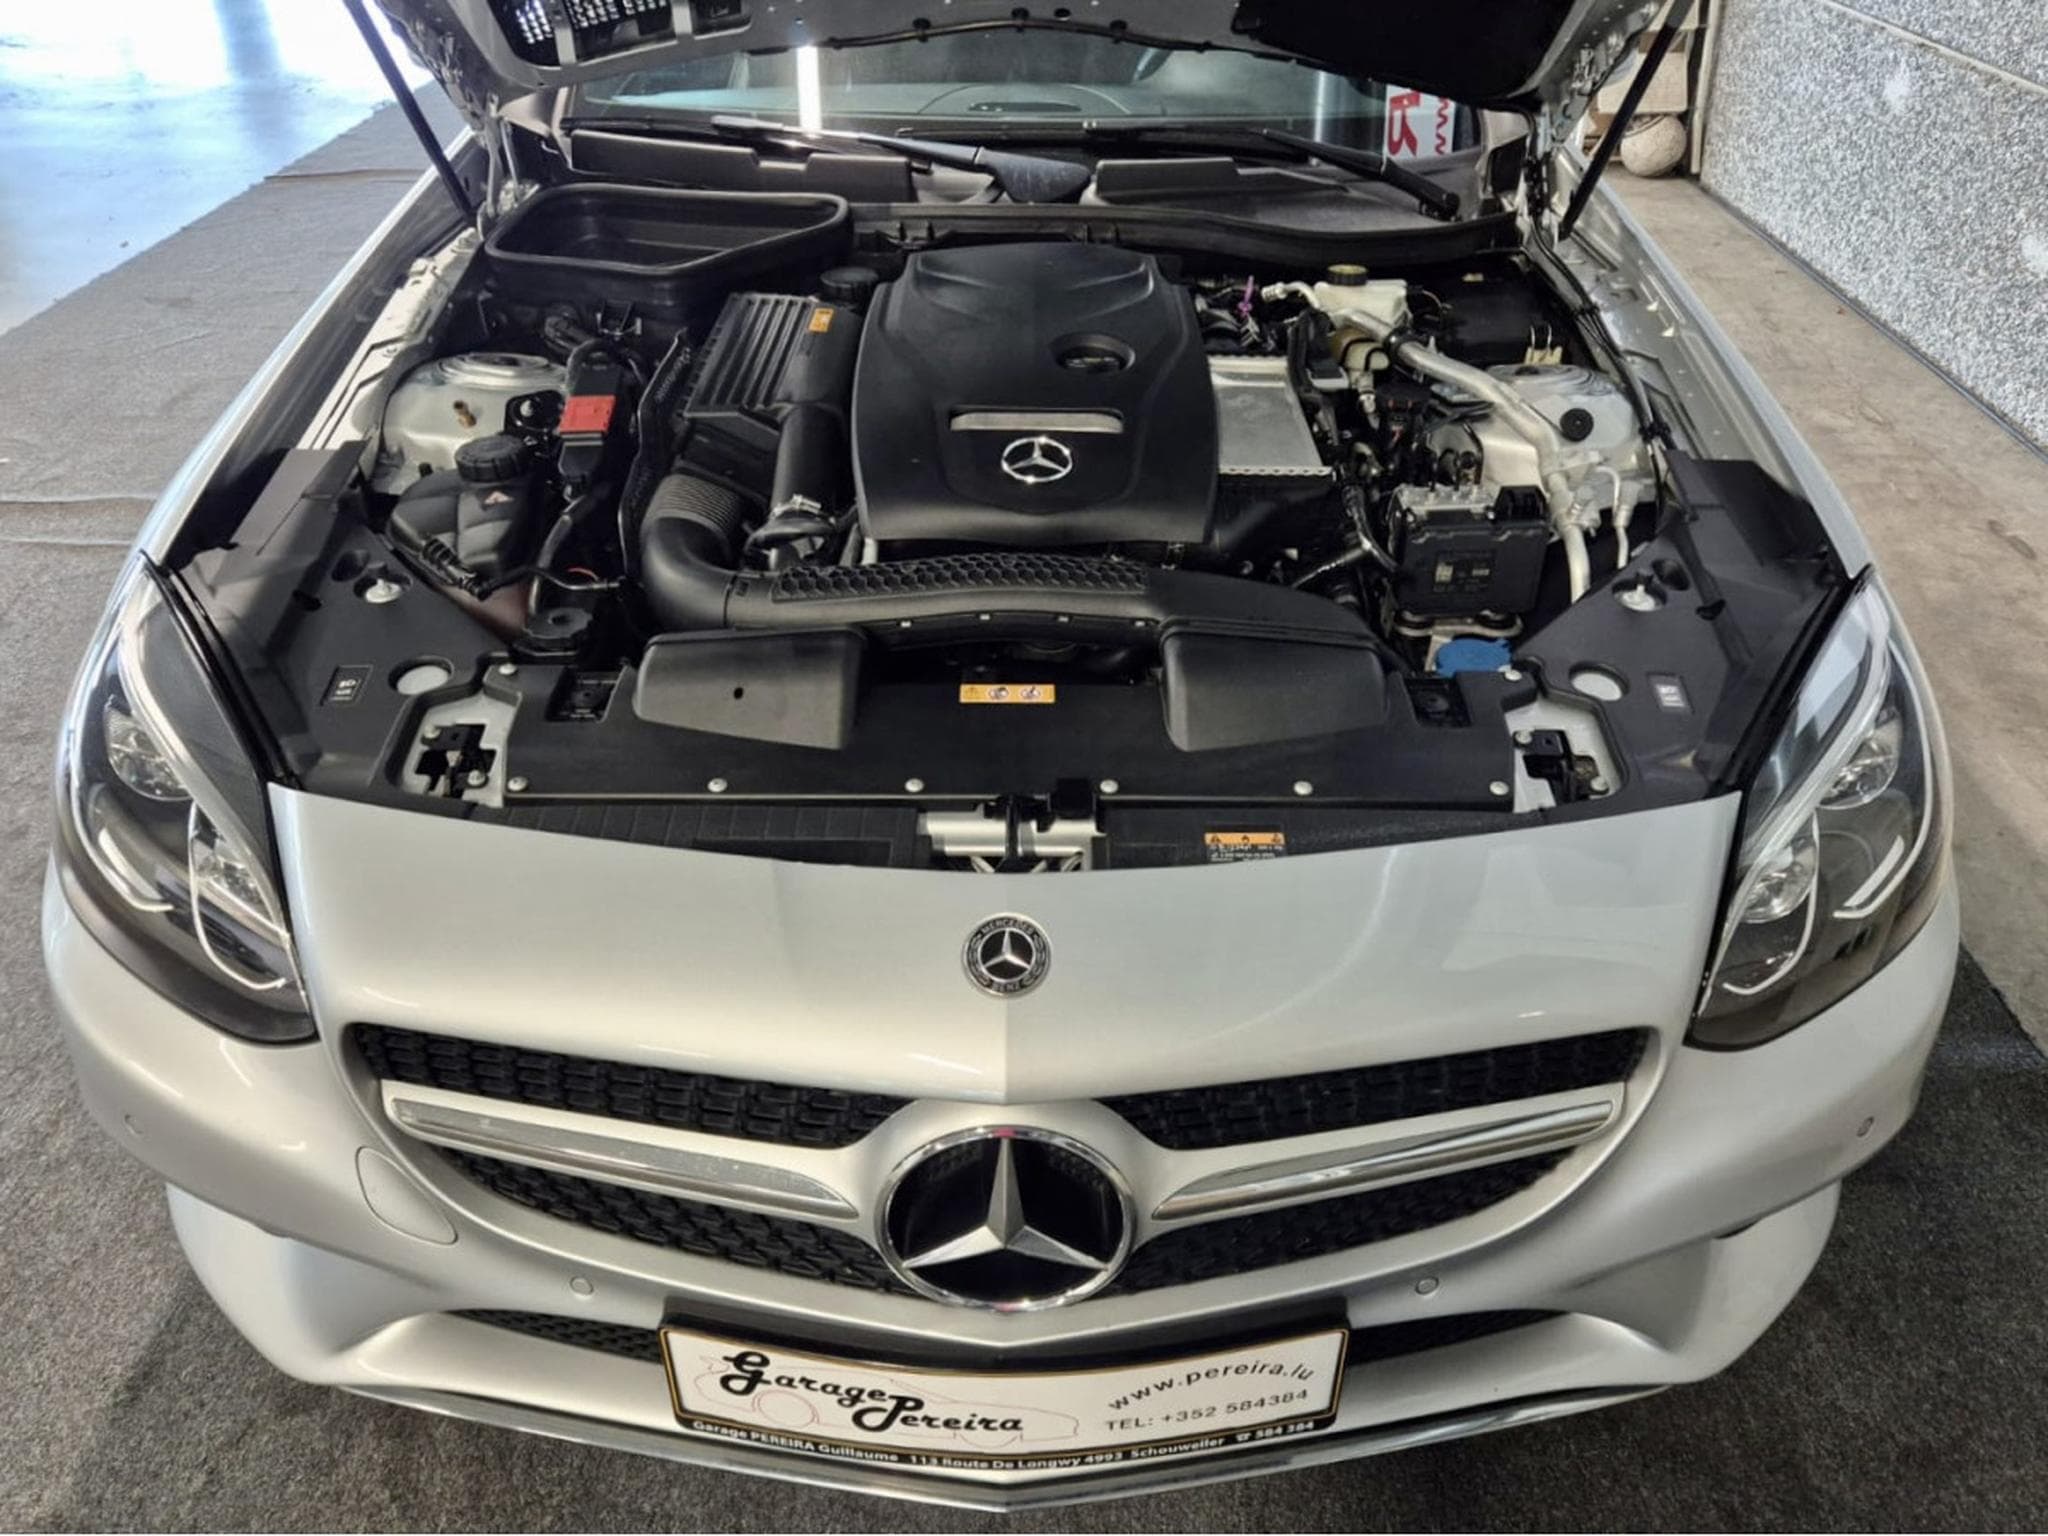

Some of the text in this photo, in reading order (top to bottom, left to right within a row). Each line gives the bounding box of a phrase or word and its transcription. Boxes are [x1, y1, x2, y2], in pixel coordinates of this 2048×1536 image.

[719, 1351, 886, 1407] Garage
[1109, 1360, 1314, 1410] www.pereira.lu
[852, 1394, 1023, 1432] Pereira
[1105, 1389, 1308, 1432] TEL: +352 584384
[693, 1420, 748, 1439] Garage
[750, 1431, 815, 1450] PEREIRA
[818, 1444, 899, 1461] Guillaume
[942, 1457, 989, 1470] Route
[992, 1459, 1014, 1469] De
[1018, 1453, 1080, 1471] Longwy
[1084, 1452, 1123, 1465] 4993
[1130, 1438, 1225, 1458] Schouweiler
[1255, 1426, 1283, 1439] 584
[1286, 1420, 1315, 1433] 384
